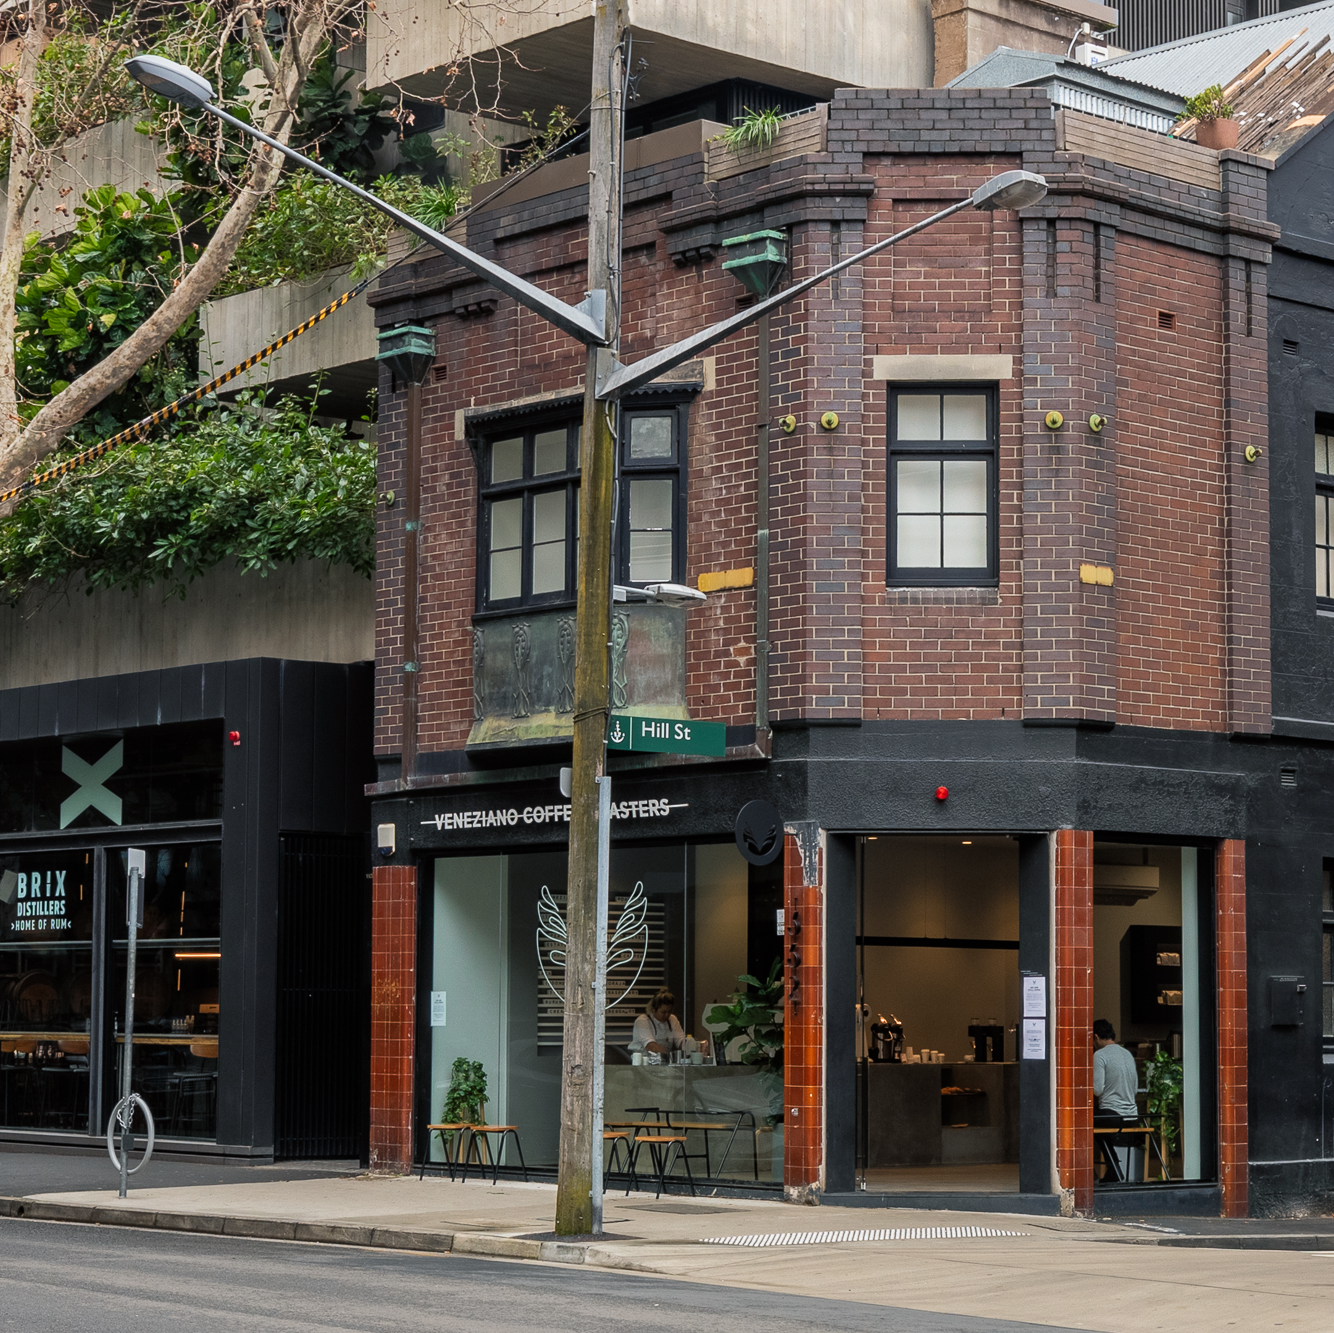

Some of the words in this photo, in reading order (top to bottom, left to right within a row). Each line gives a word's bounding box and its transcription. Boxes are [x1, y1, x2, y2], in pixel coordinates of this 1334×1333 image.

[641, 721, 669, 739] Hill
[674, 723, 691, 740] St
[434, 808, 518, 830] VENEZIANO
[523, 804, 572, 823] COFFE
[610, 798, 670, 819] ASTERS
[17, 870, 67, 898] BRIX
[17, 900, 66, 916] DISTILLERS
[15, 919, 35, 931] HOME
[38, 919, 47, 930] OF
[50, 918, 67, 930] RUM
